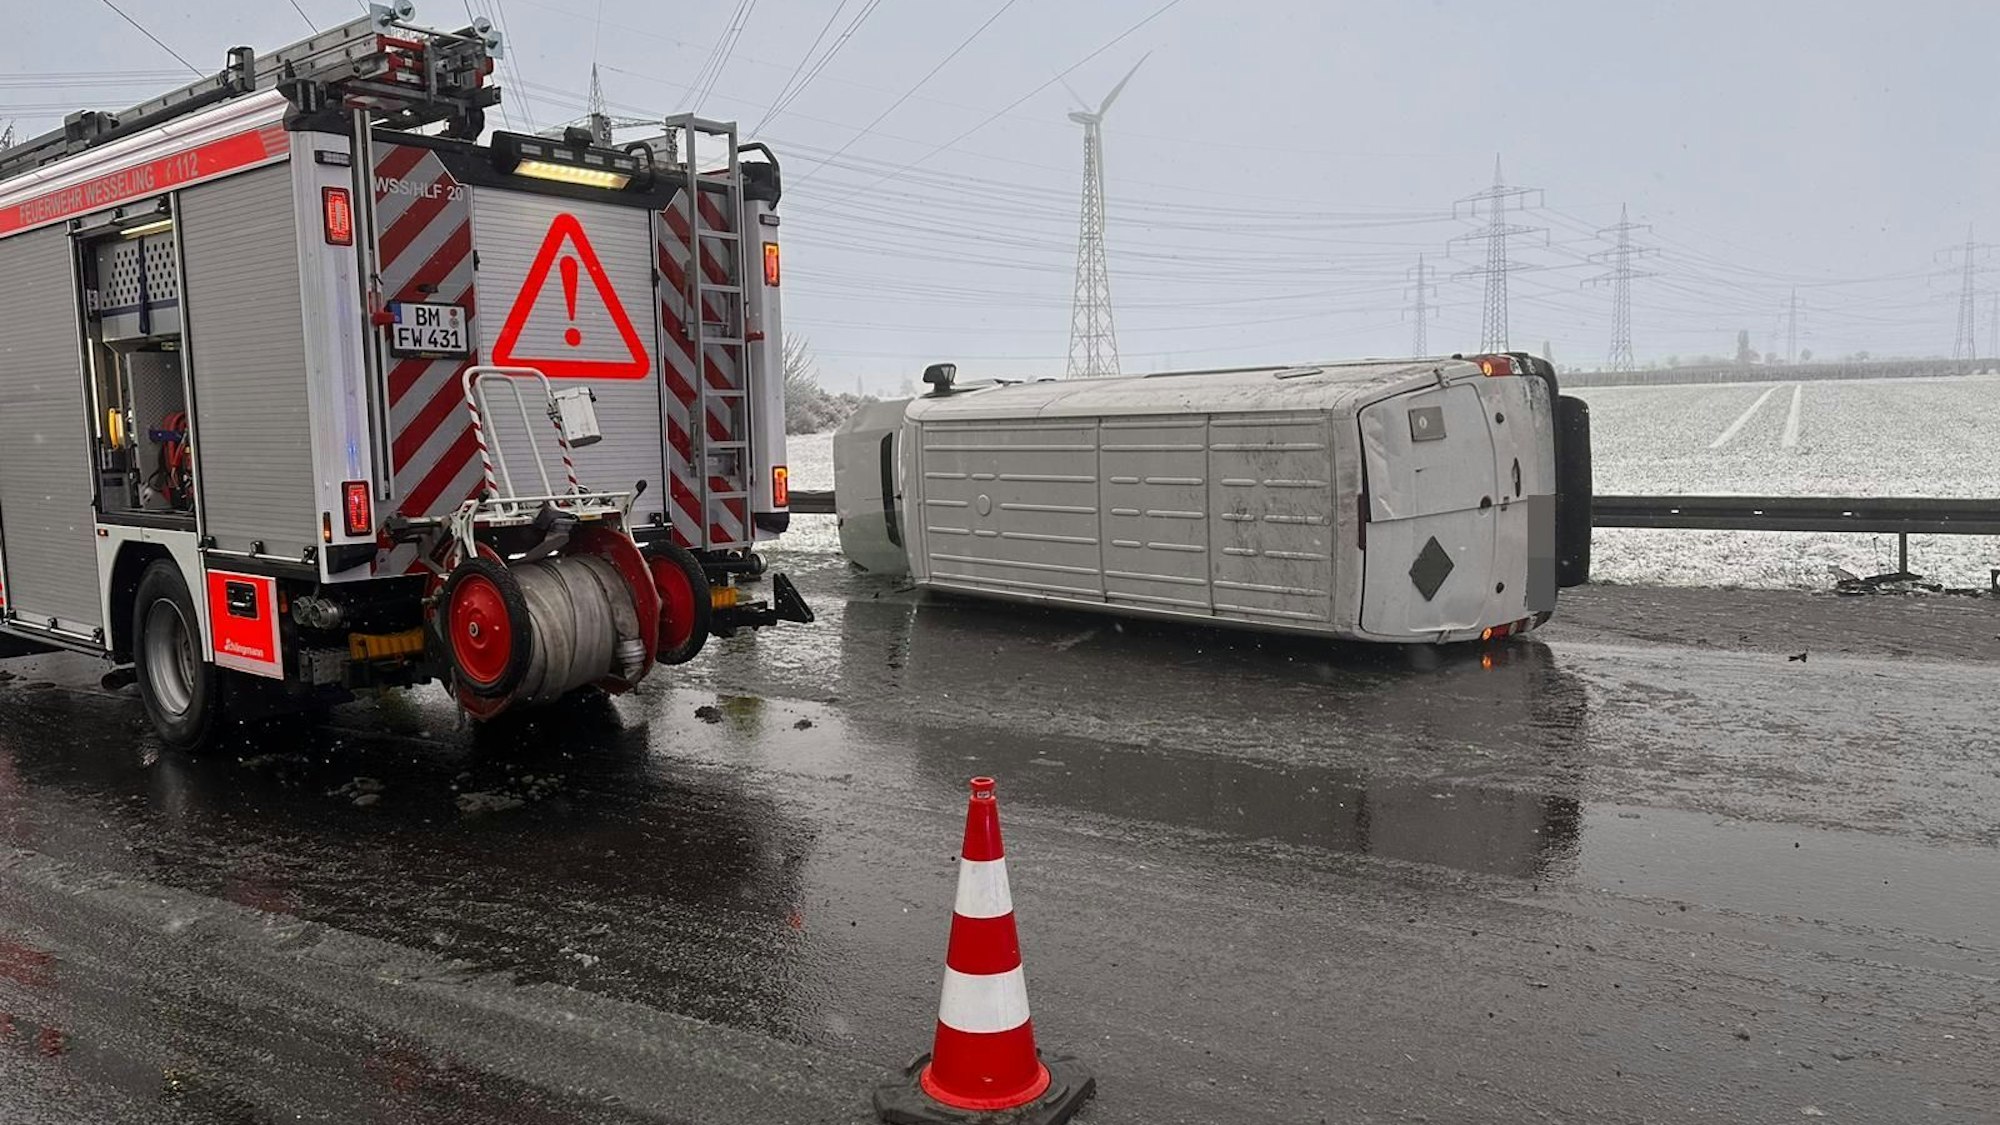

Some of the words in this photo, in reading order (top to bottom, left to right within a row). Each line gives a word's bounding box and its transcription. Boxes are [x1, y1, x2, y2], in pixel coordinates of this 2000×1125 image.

[19, 190, 84, 225] FEUERWEHR
[85, 166, 155, 205] WESSELING
[175, 152, 199, 180] 112
[374, 175, 443, 200] WSS/HLF
[446, 186, 464, 201] 20
[415, 307, 441, 328] BM
[398, 327, 423, 348] FW
[428, 329, 462, 349] 431
